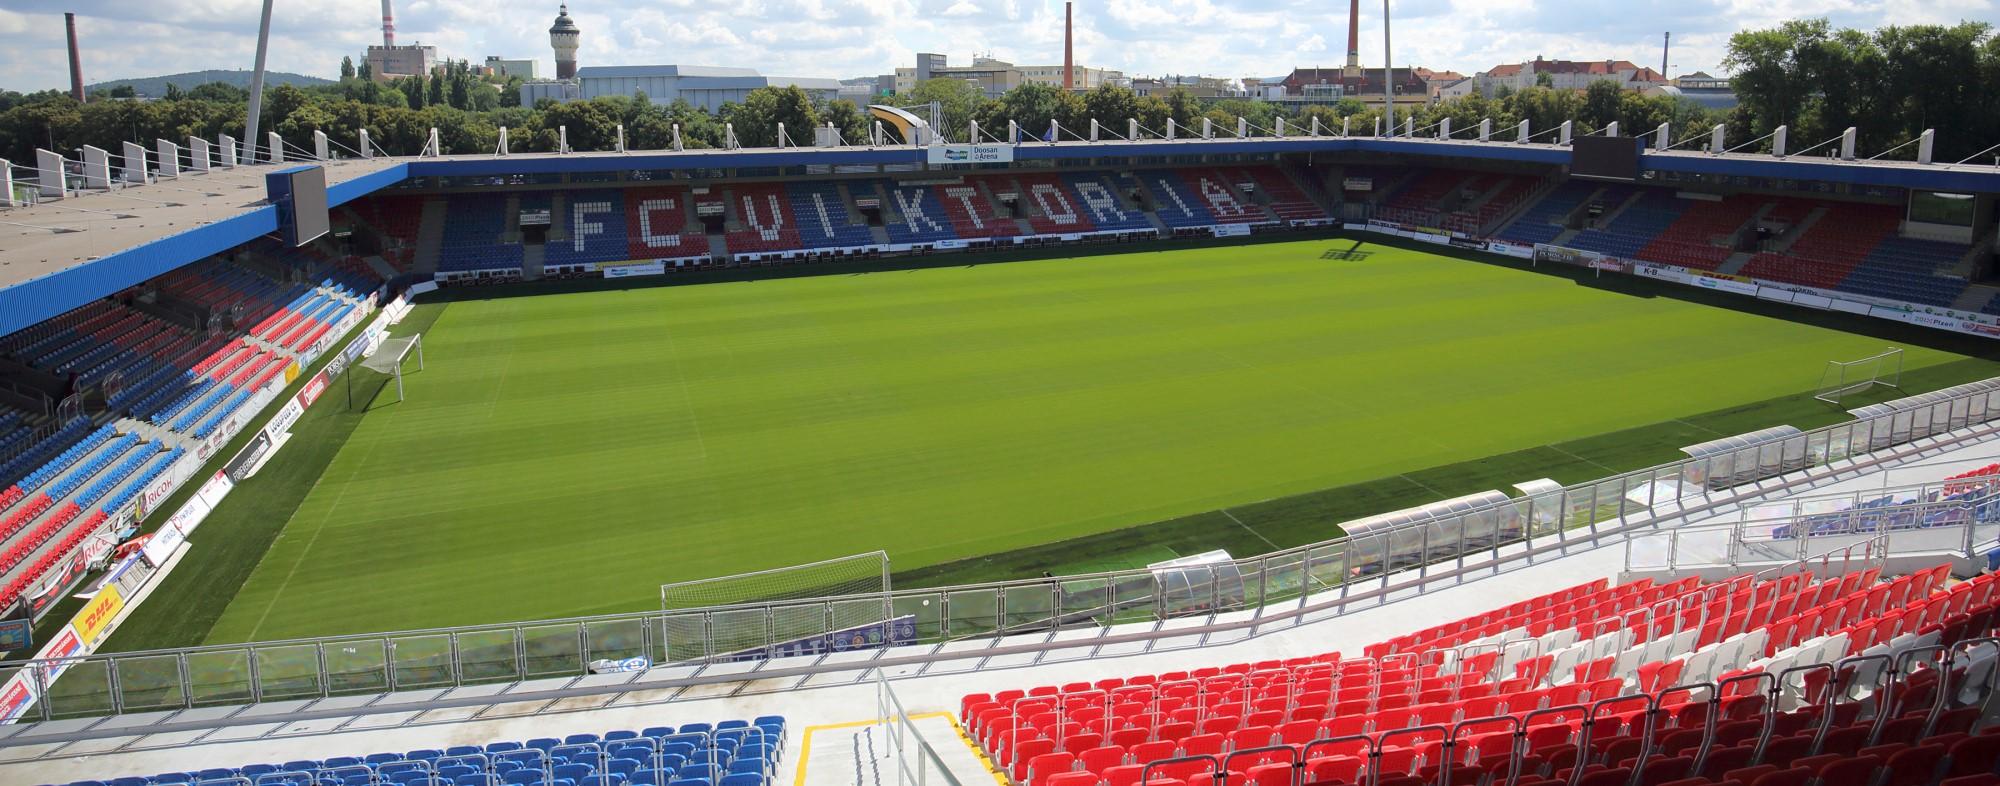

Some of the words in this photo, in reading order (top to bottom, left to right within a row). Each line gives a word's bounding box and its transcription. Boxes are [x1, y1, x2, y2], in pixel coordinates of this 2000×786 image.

[573, 199, 681, 251] FC
[743, 178, 1244, 241] VIKTORIA
[147, 476, 173, 505] RICOH
[85, 597, 115, 631] DHL
